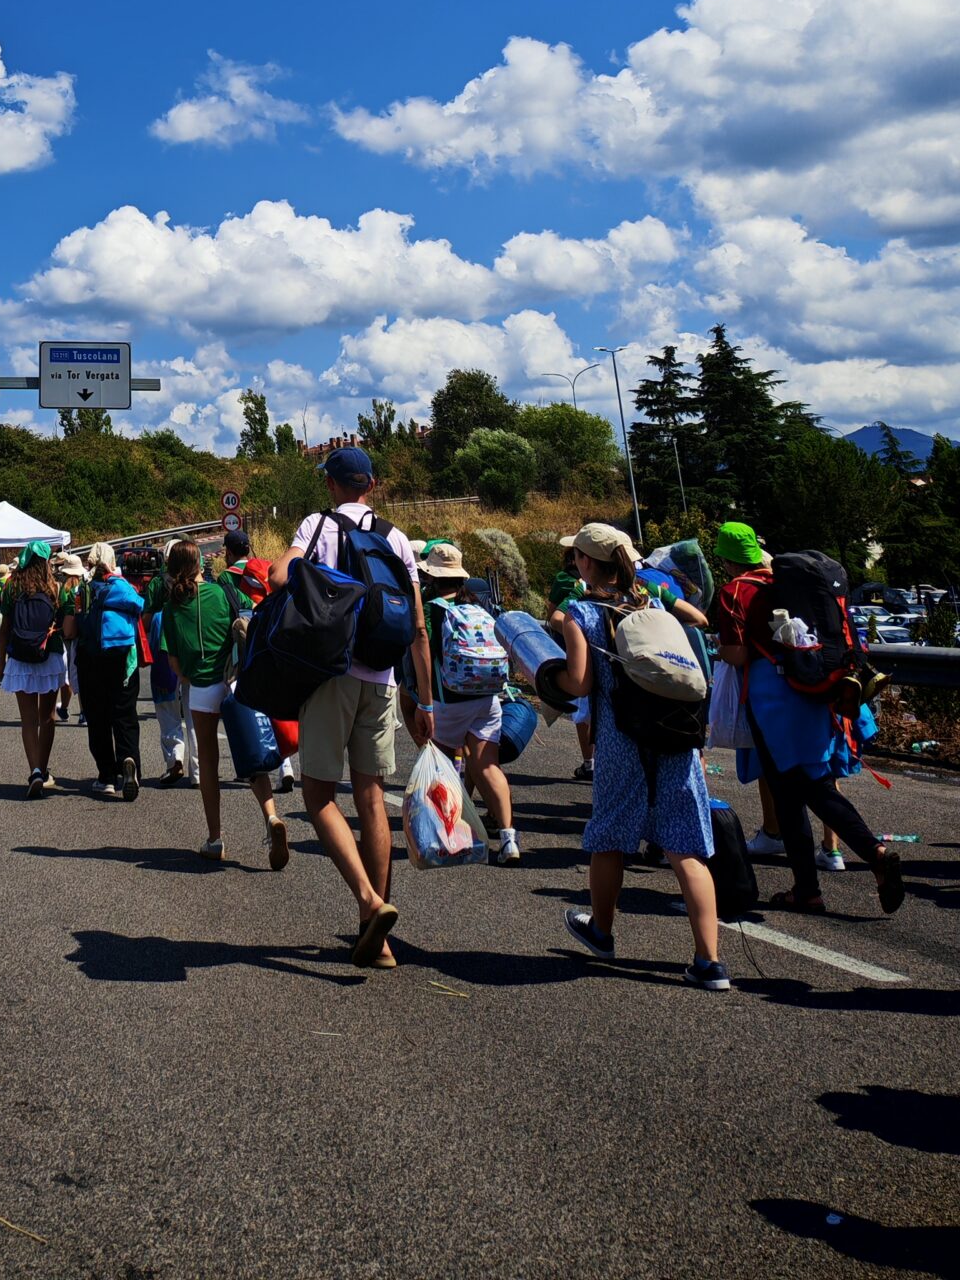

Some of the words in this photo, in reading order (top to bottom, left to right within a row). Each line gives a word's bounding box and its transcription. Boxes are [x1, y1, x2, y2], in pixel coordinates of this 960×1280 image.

[73, 350, 118, 361] Tuscolana
[50, 372, 62, 380] via
[67, 370, 80, 380] Tor
[85, 370, 120, 381] Vergata
[225, 496, 236, 506] 40
